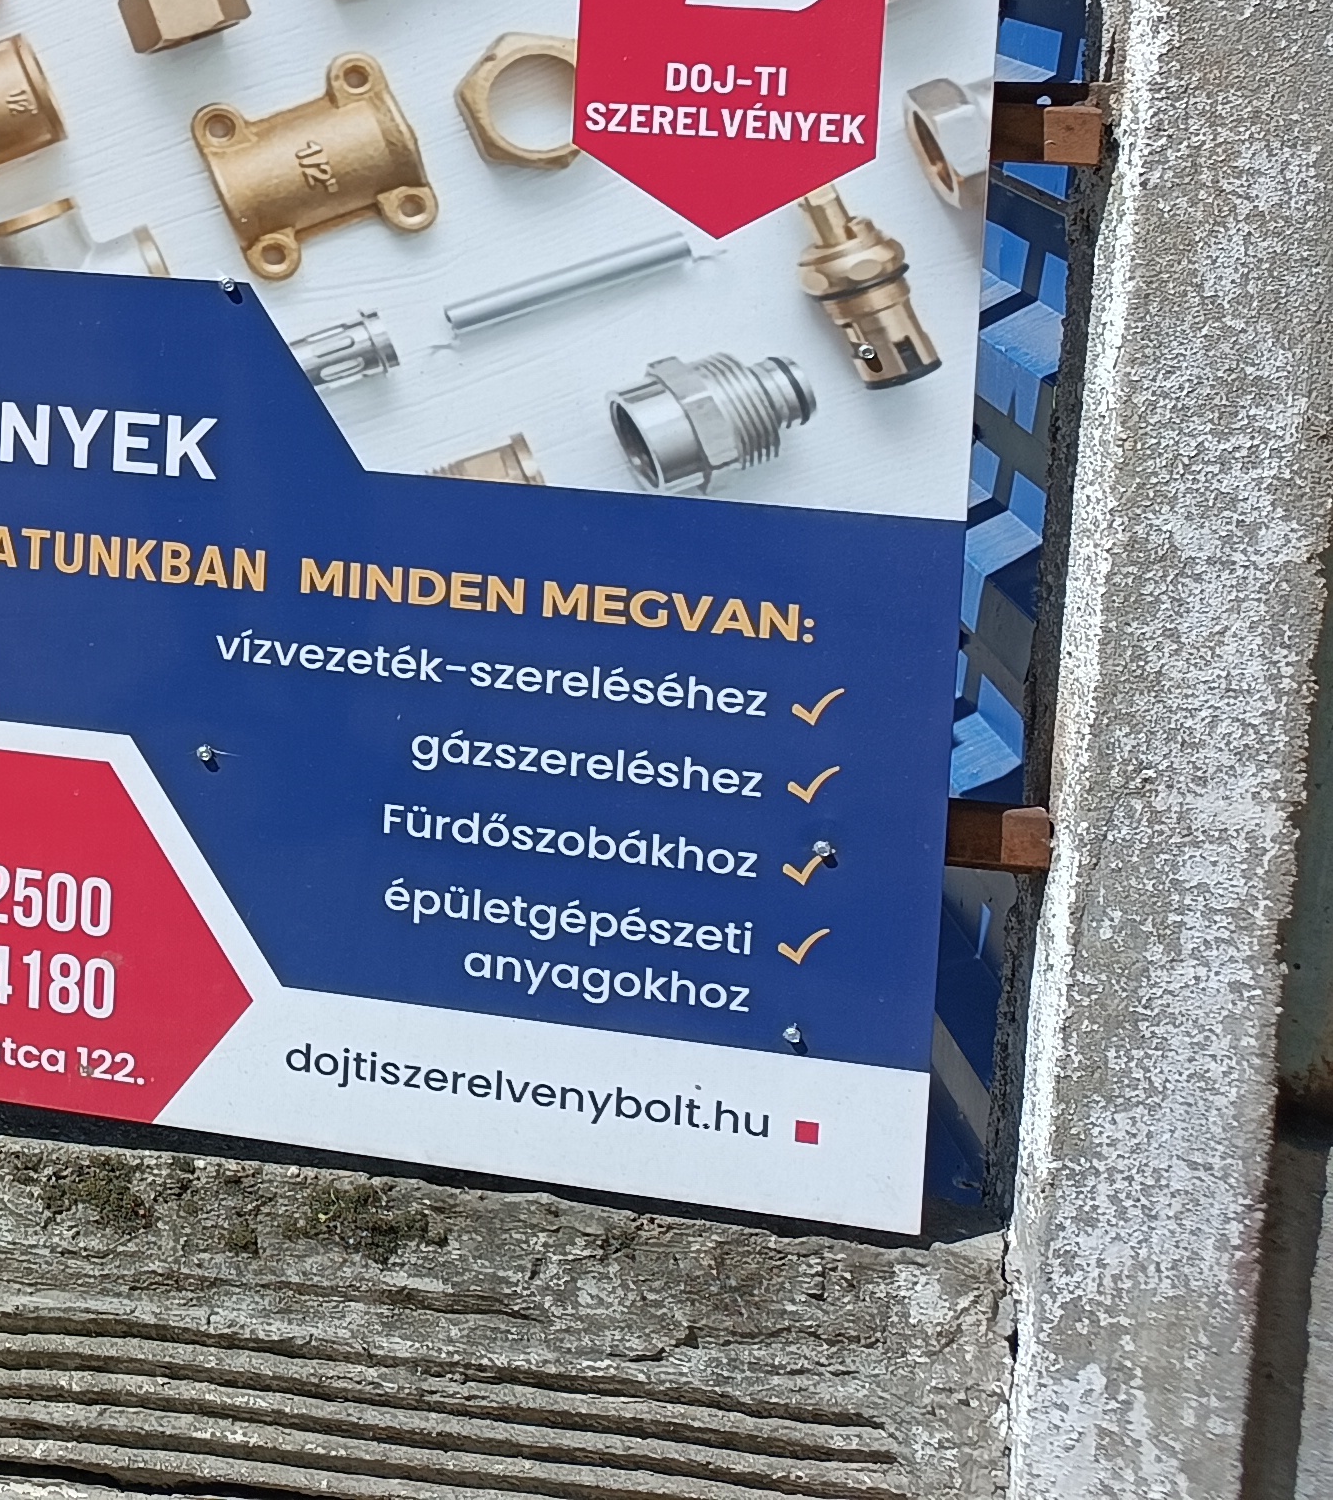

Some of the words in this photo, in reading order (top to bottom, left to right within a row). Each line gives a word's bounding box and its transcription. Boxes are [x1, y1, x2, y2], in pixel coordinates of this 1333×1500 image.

[664, 61, 787, 97] DOJ-TI
[584, 101, 867, 145] SZERELVÉNYEK
[299, 556, 524, 616] MINDEN
[541, 579, 817, 645] MEGVAN:
[215, 628, 768, 718] vízvezeték-szereléséhez
[411, 729, 764, 798] gázszereléshez
[382, 803, 758, 879] Fürdőszobákhoz
[383, 878, 754, 957] épületgépészeti
[464, 948, 750, 1014] anyagokhoz
[76, 1046, 146, 1087] 122.
[285, 1042, 771, 1138] dojtiszerelvenybolt.hu
